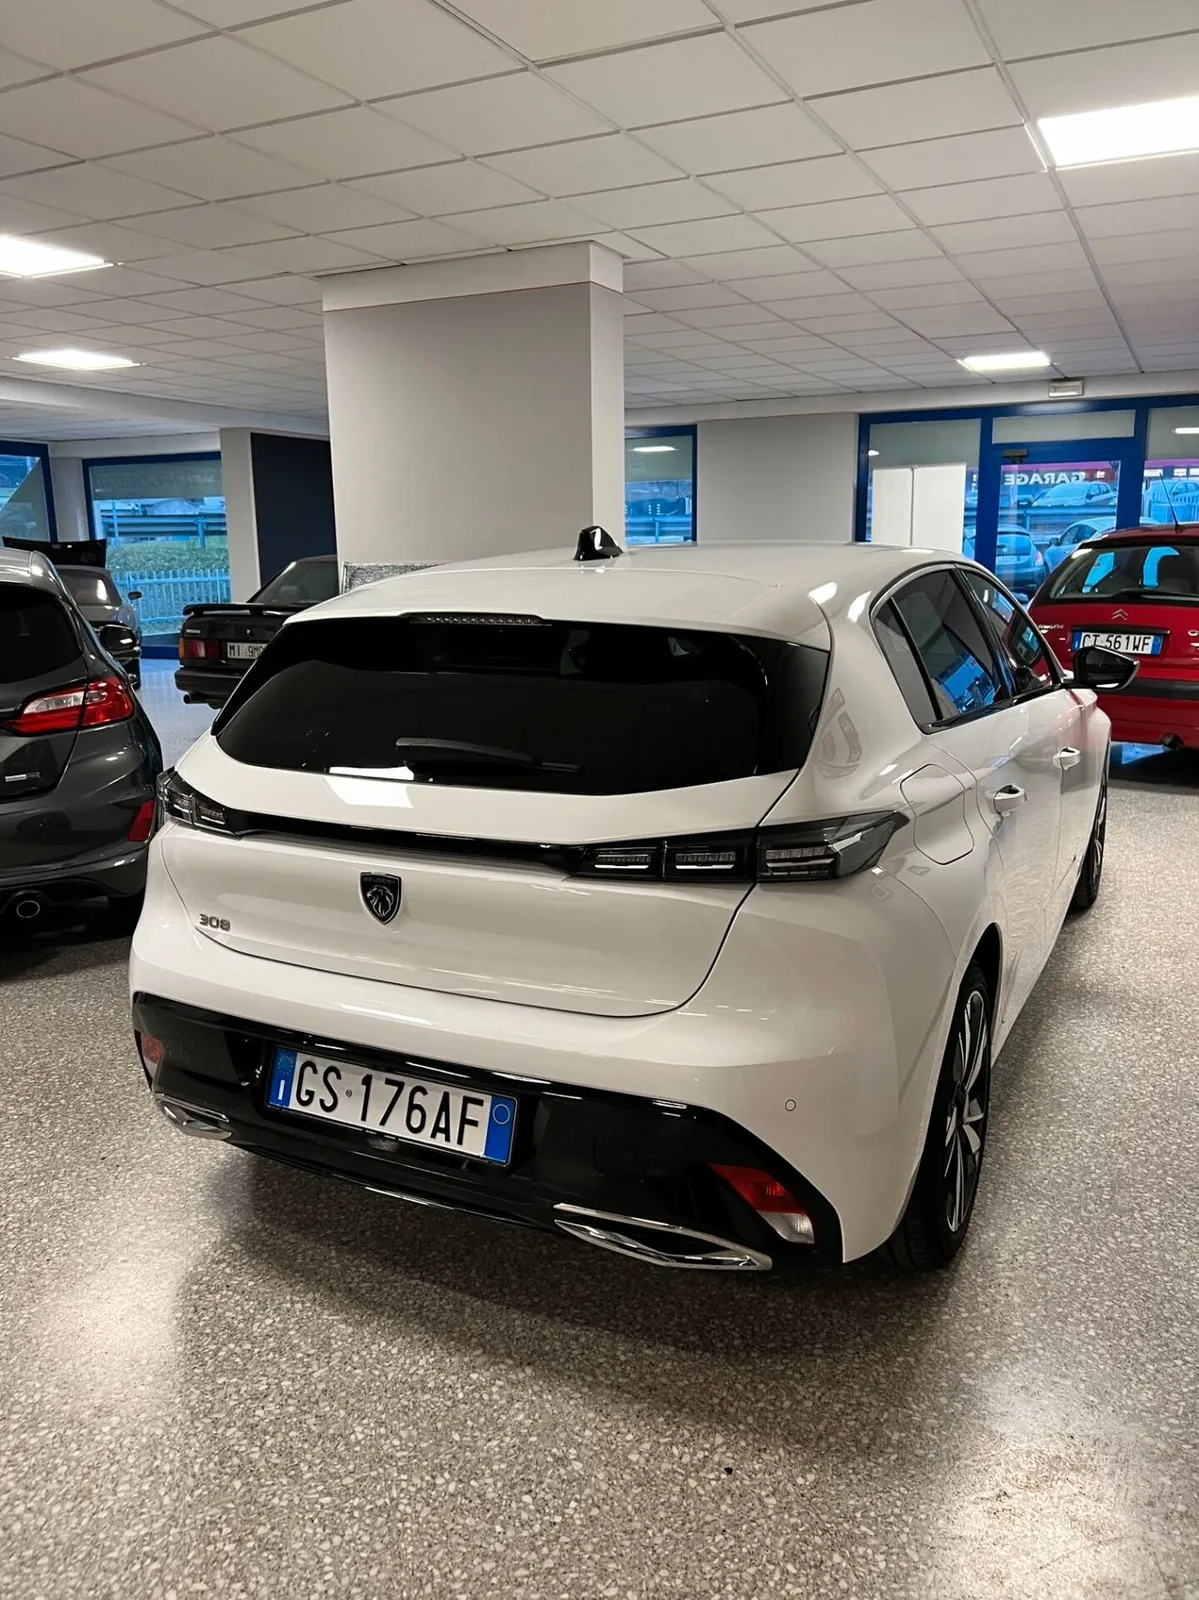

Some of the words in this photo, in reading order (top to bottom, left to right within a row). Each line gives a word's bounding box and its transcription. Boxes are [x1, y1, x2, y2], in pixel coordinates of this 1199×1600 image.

[1105, 634, 1151, 651] 561WF
[199, 913, 231, 931] 308
[296, 1060, 342, 1113] GS
[361, 1074, 484, 1146] 176AF
